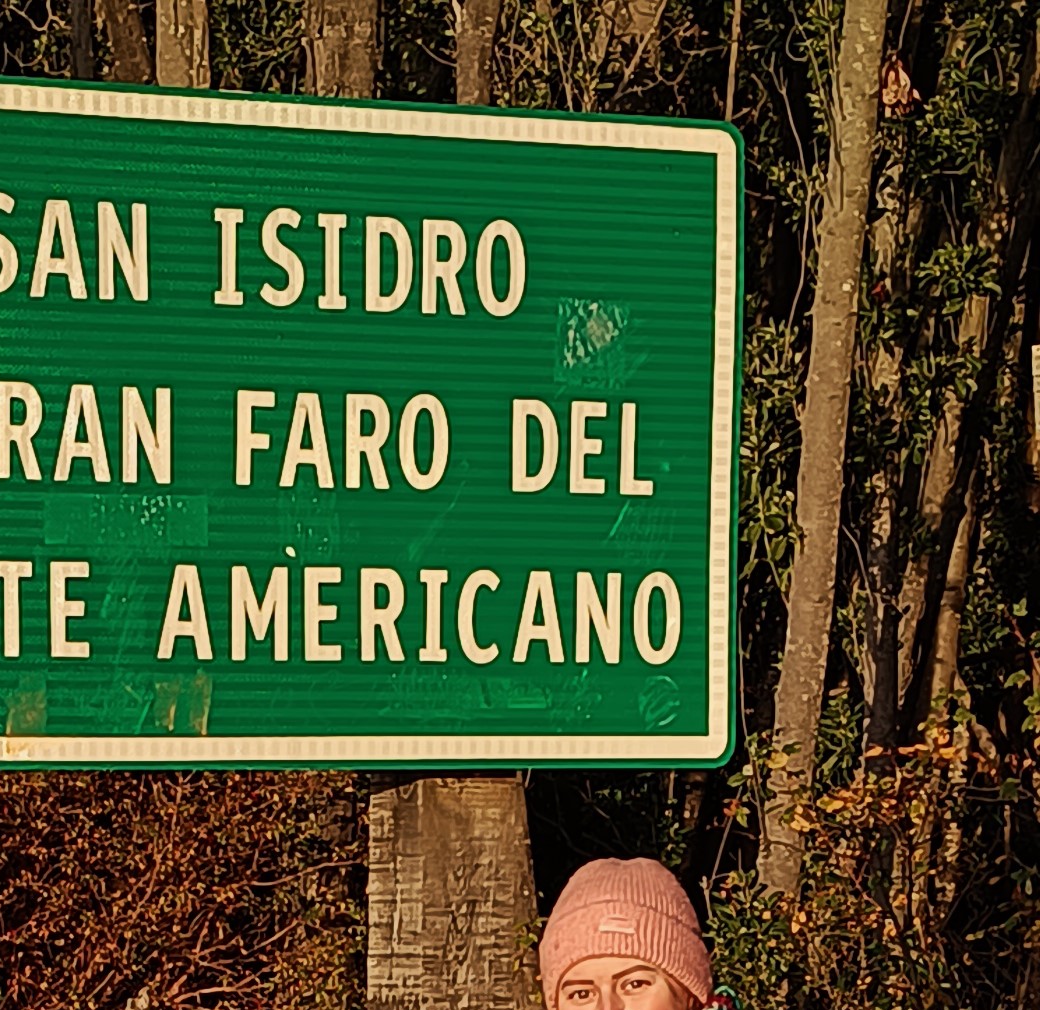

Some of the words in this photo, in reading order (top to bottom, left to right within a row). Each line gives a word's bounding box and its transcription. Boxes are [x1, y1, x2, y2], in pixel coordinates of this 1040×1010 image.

[213, 207, 527, 317] ISIDRO
[235, 388, 450, 490] FARO
[511, 398, 655, 496] DEL
[156, 564, 682, 665] AMERICANO
